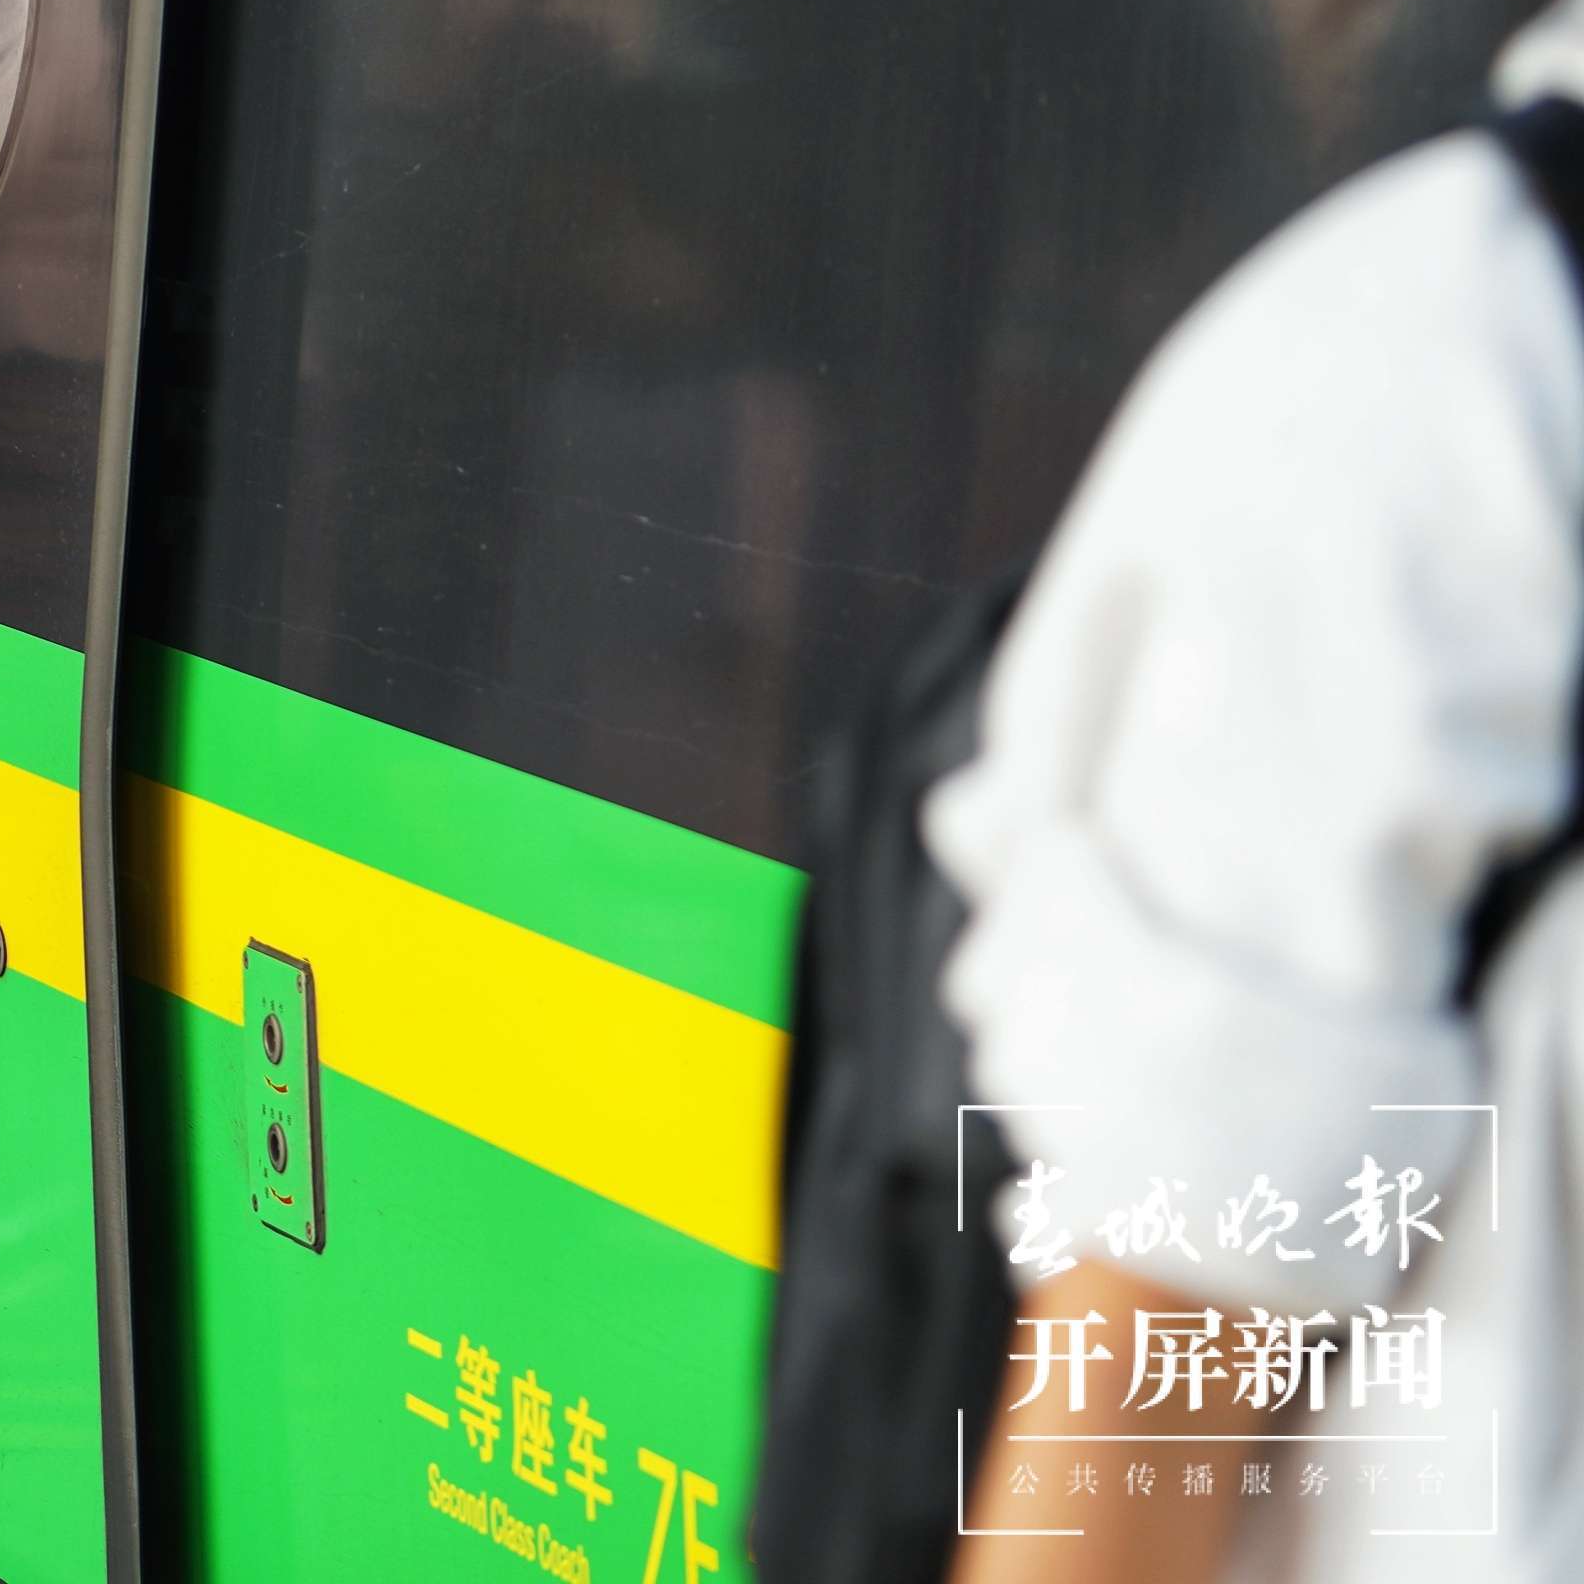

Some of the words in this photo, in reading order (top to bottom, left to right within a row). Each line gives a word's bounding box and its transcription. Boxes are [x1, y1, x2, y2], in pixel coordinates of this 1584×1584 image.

[405, 1327, 613, 1522] 二等座车
[428, 1462, 488, 1535] Second
[490, 1497, 537, 1561] Class
